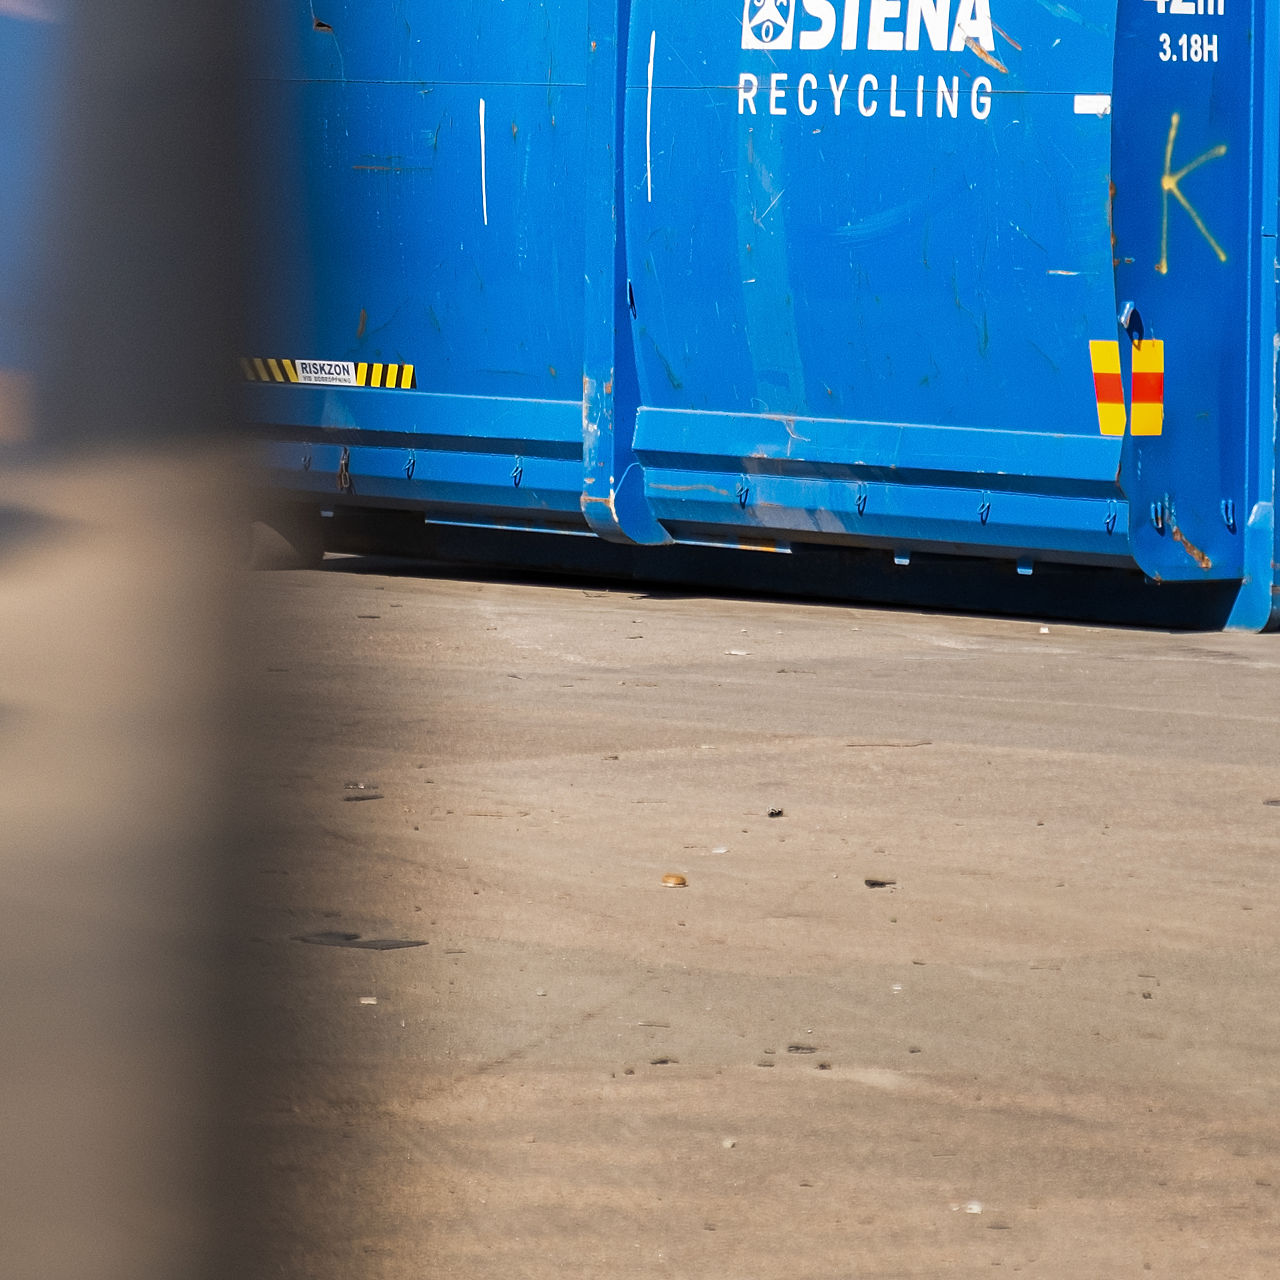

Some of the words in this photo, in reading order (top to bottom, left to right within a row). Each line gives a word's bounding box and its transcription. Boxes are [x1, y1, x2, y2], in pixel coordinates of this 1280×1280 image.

[1159, 32, 1218, 62] 3.18H
[737, 72, 993, 120] RECYCLING
[300, 362, 351, 376] RISKZON
